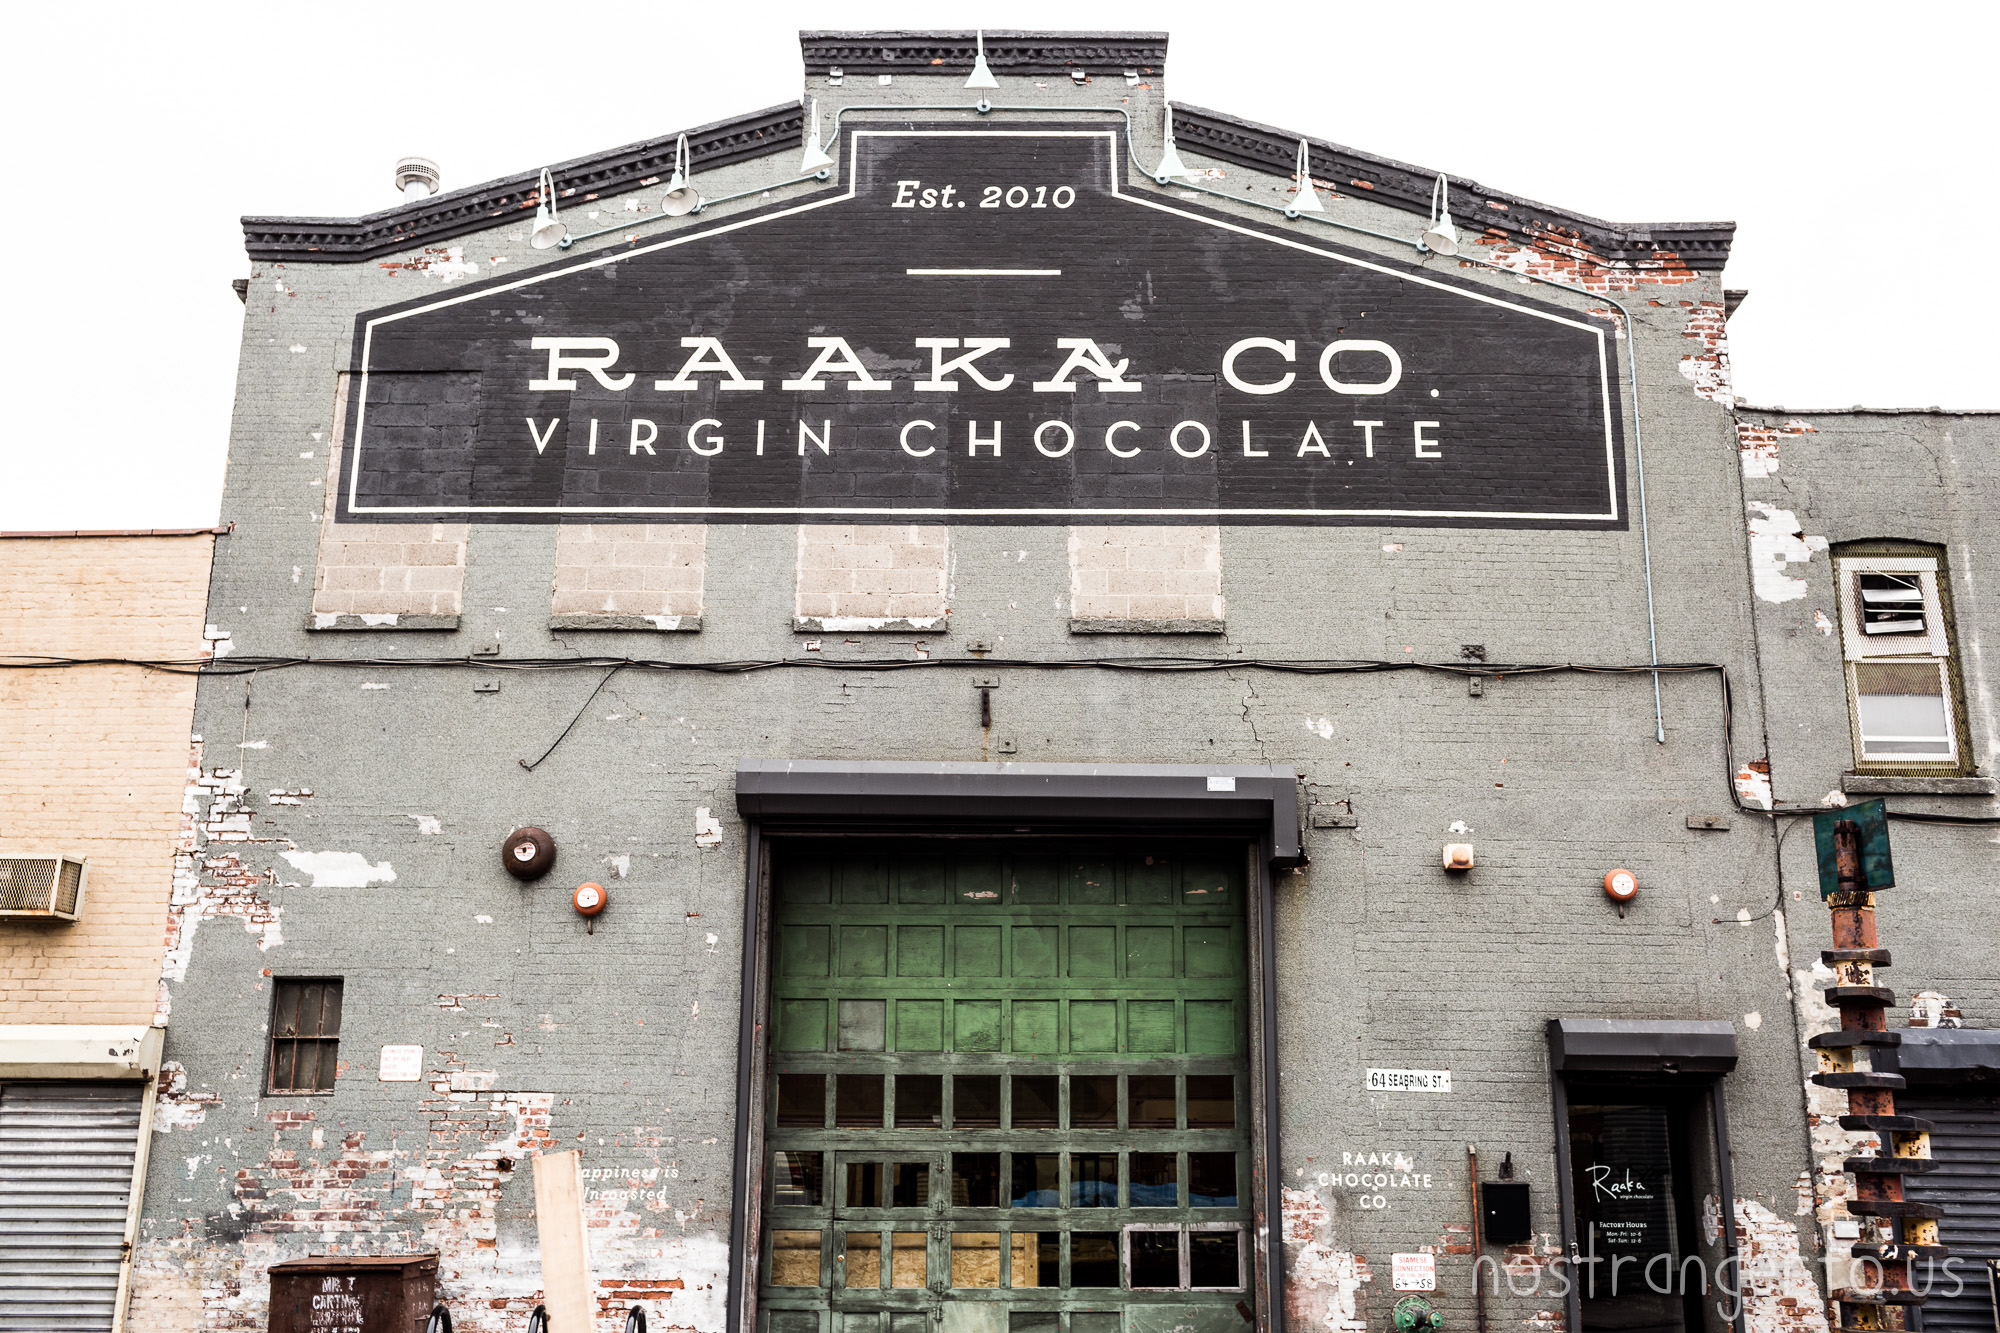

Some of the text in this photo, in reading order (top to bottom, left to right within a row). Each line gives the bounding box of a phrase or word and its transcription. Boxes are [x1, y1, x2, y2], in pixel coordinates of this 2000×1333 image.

[891, 180, 1076, 209] Est. 2010
[528, 336, 1440, 398] RAAKA CO.
[525, 417, 1442, 458] VIRGIN CHOCOLATE
[1371, 1072, 1386, 1088] 64
[1388, 1073, 1428, 1088] SEABRING
[1342, 1151, 1405, 1166] RAAKA
[581, 1165, 679, 1182] appiness is
[1318, 1173, 1432, 1188] CHOCOLATE
[1584, 1161, 1646, 1203] Raaka
[1359, 1194, 1392, 1209] CO.
